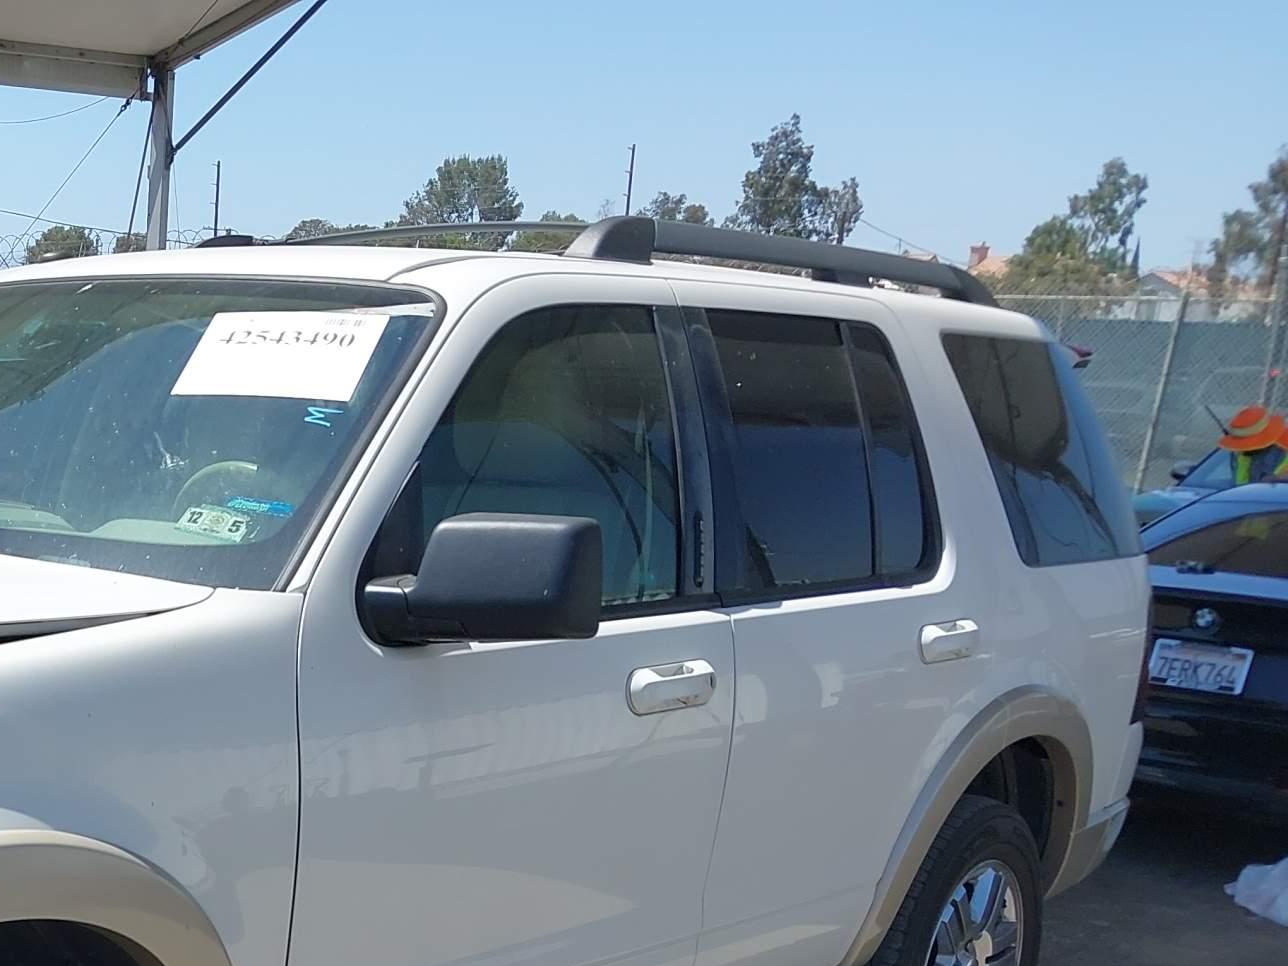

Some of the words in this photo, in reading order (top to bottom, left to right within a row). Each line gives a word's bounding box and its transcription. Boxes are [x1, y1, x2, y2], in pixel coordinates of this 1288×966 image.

[215, 329, 356, 348] 42543490
[186, 510, 204, 525] 12
[227, 519, 245, 534] 5
